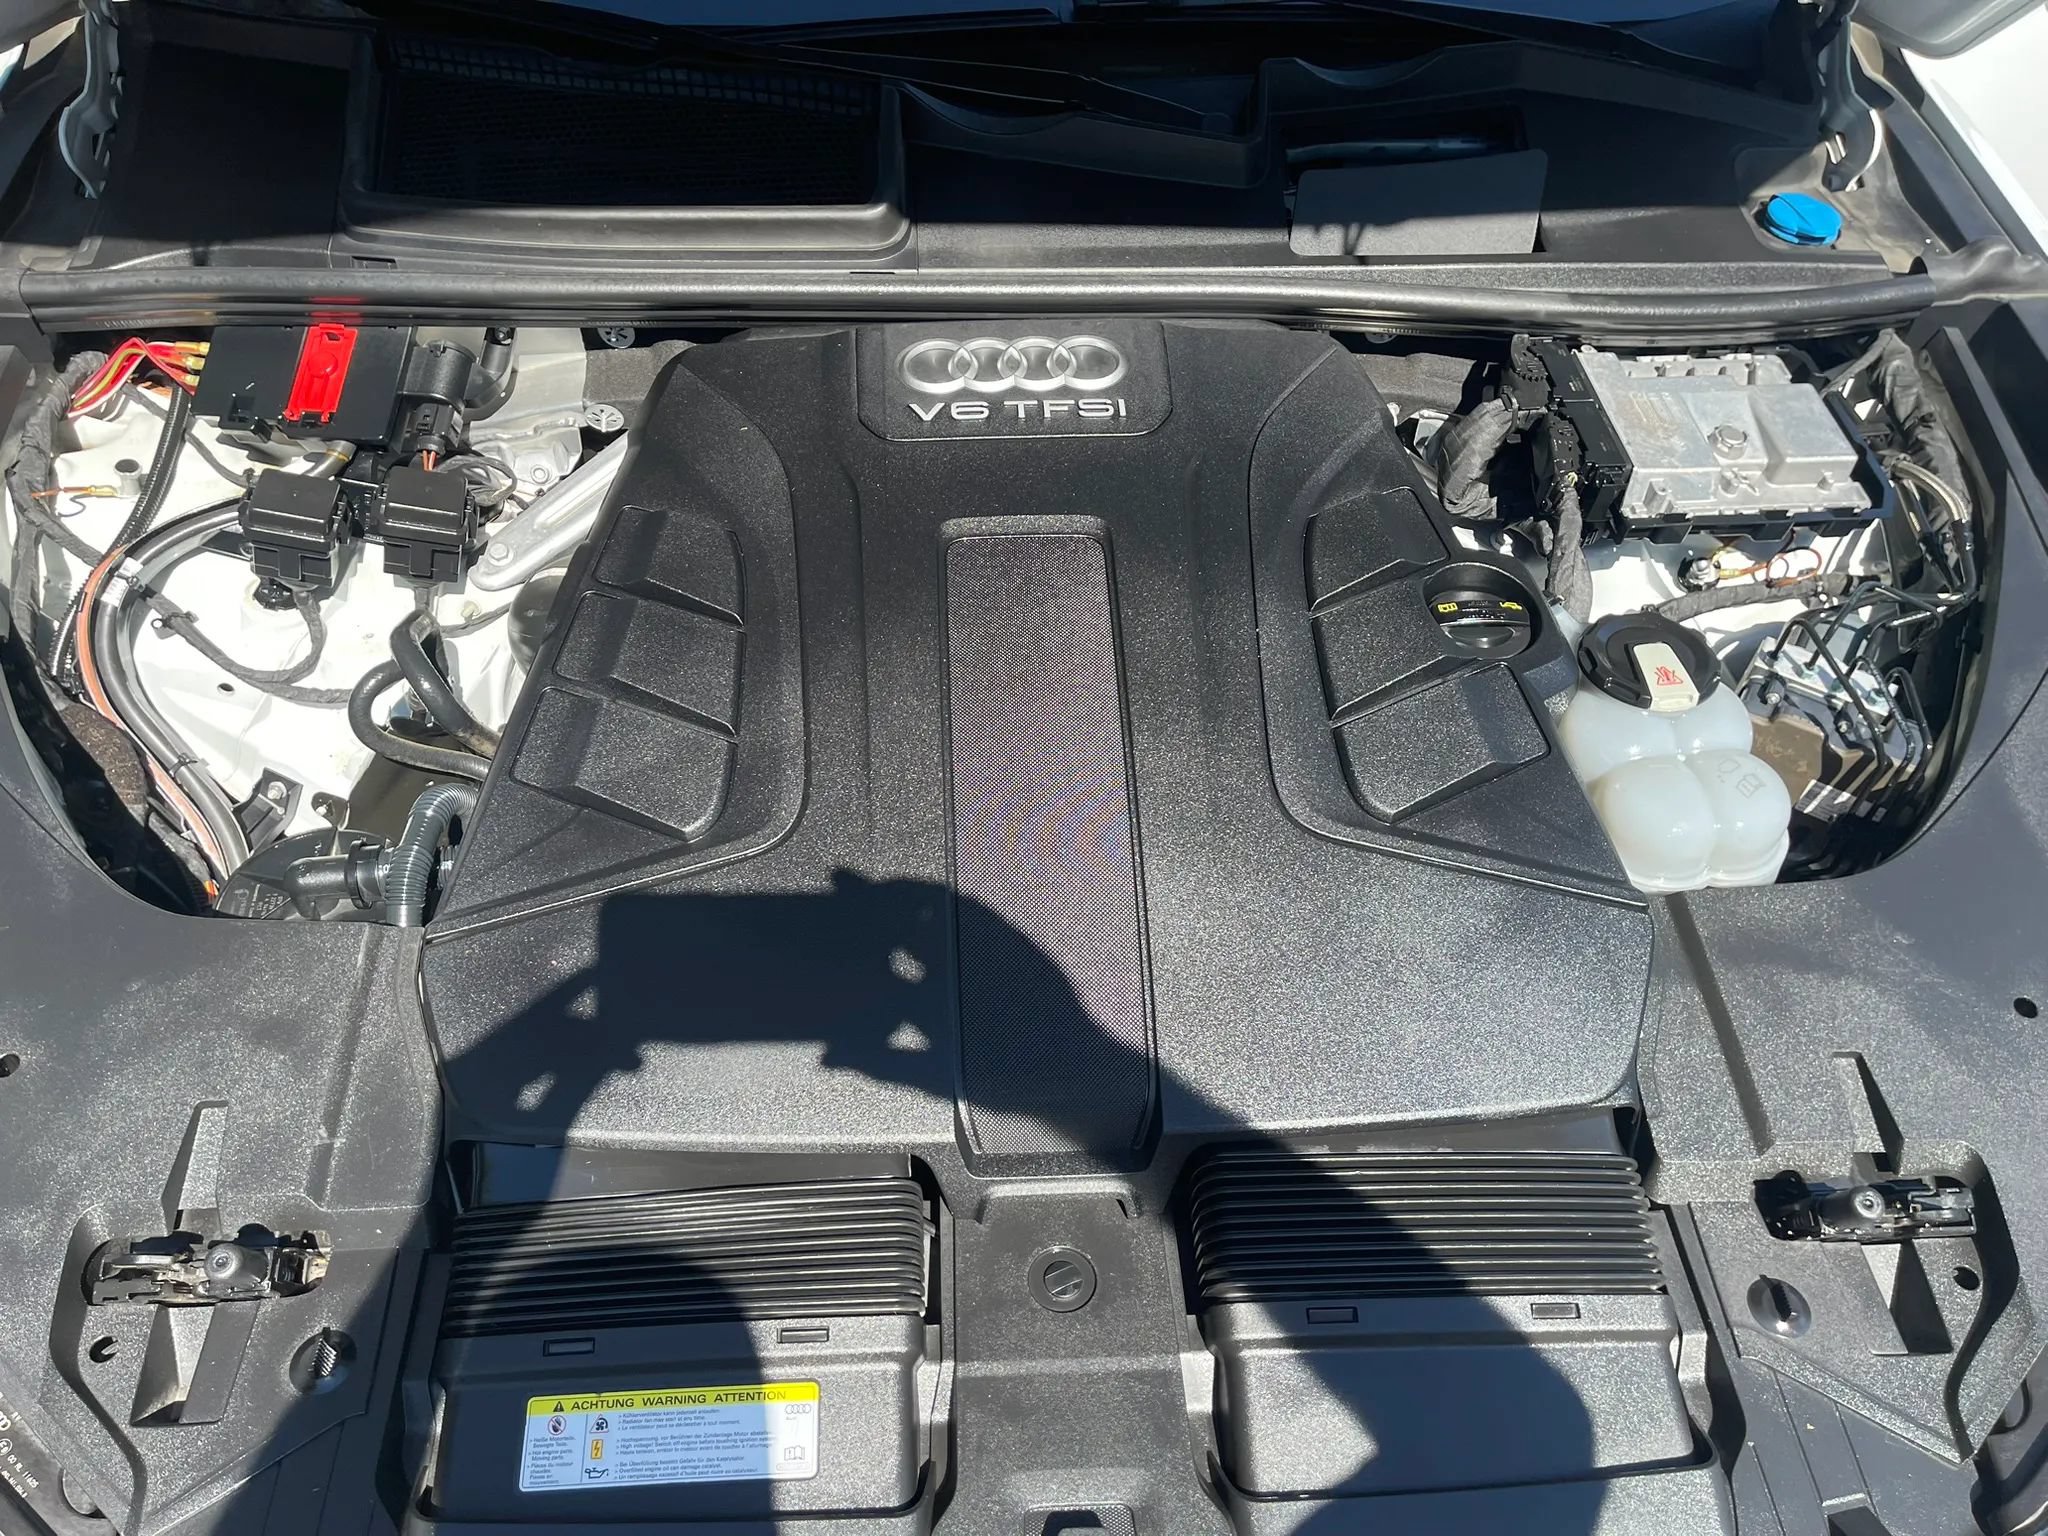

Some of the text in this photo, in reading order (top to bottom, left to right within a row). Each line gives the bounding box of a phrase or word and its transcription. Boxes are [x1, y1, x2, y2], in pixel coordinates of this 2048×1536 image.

[908, 398, 1127, 422] V6 TFSI
[571, 1391, 786, 1411] ACHTUNG WARNING ATTENTION
